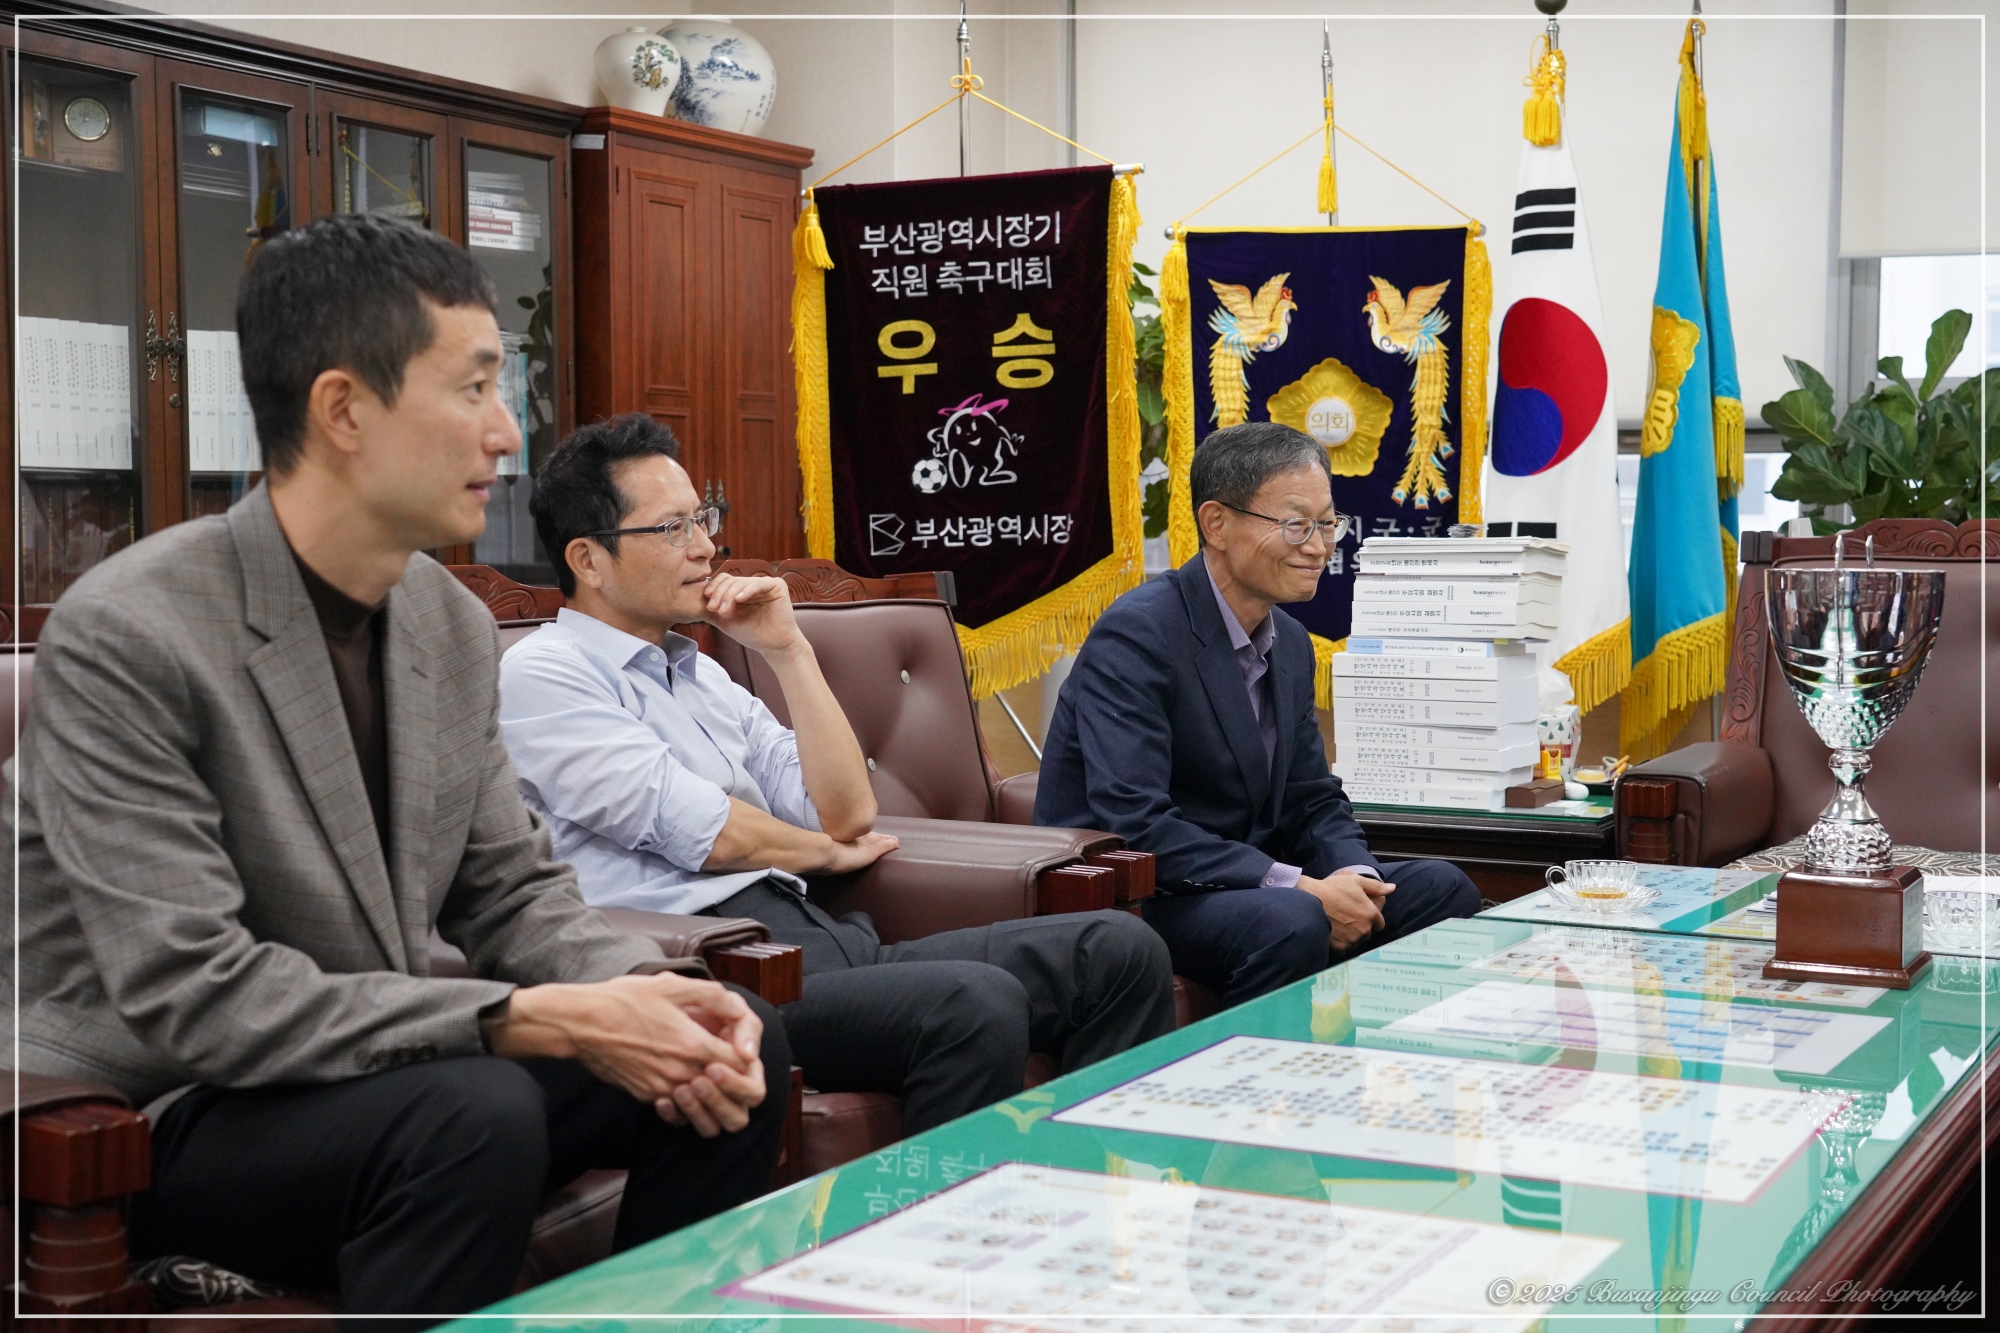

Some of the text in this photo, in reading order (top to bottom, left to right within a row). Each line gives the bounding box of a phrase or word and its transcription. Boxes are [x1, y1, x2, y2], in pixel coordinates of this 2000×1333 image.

[859, 210, 1062, 258] 부산광역시장기
[871, 256, 1053, 300] 직원 축구대회
[1311, 412, 1352, 434] 의회
[911, 515, 1074, 549] 부산광역시장
